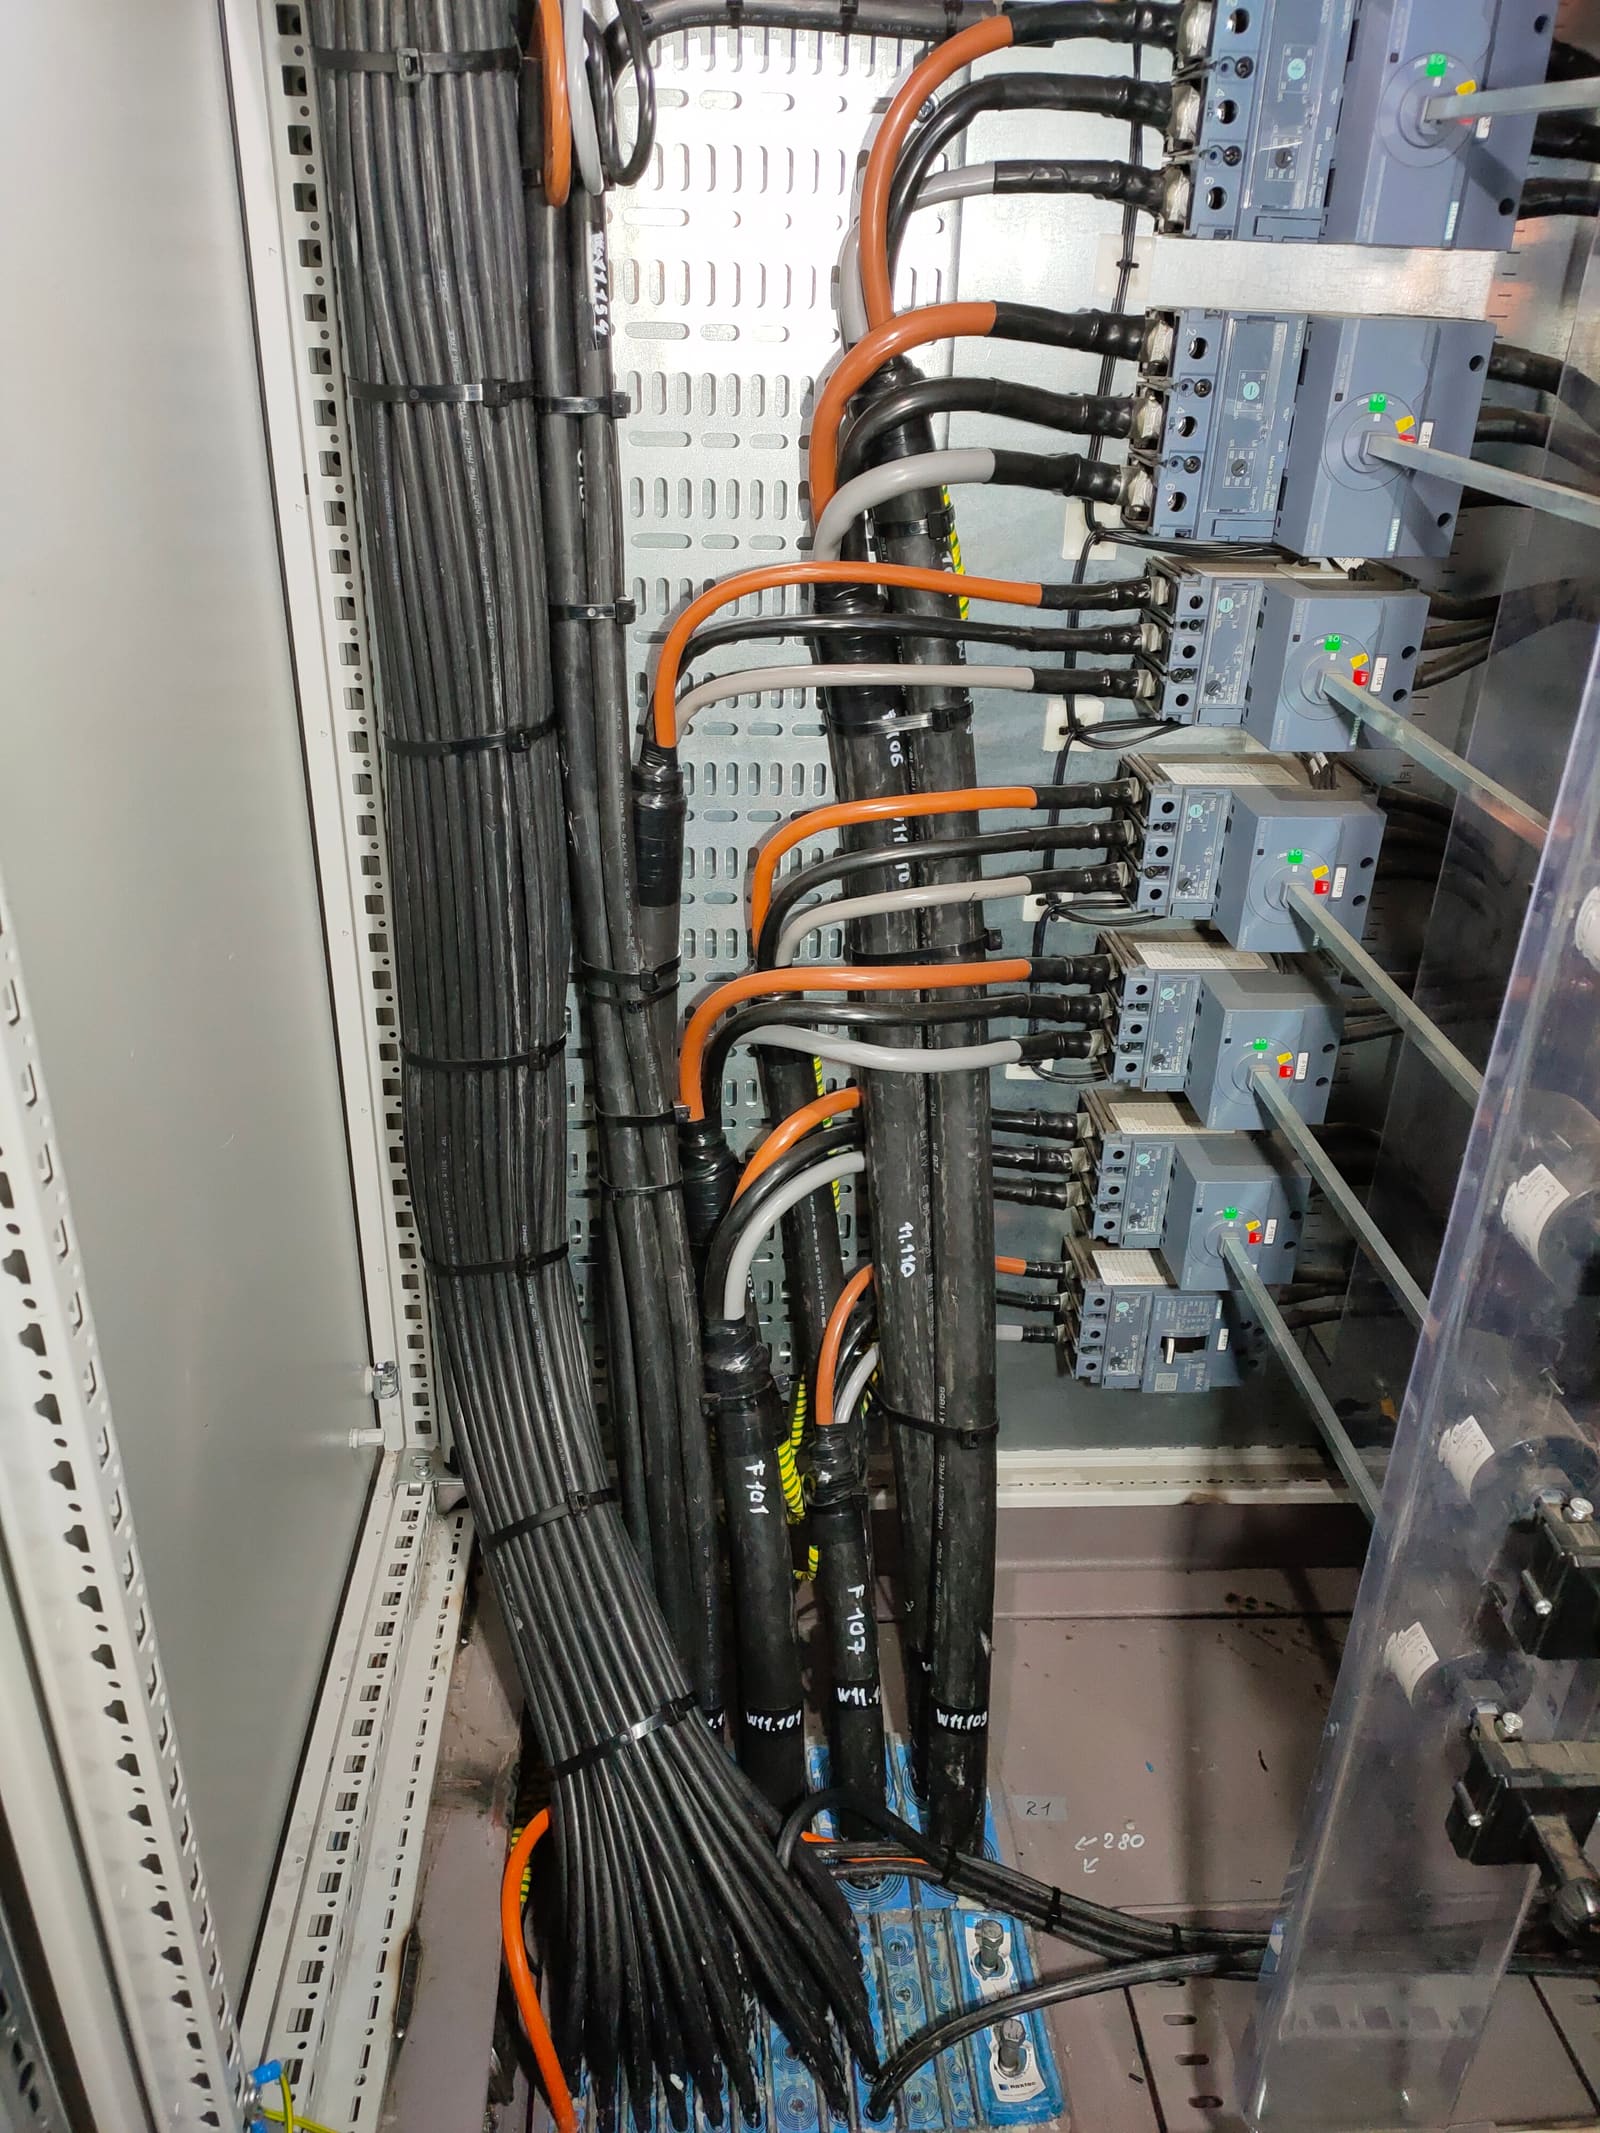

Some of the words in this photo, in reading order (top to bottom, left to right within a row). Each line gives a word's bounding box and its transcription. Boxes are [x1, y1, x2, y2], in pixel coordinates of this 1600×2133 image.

[1215, 87, 1226, 98] 4
[1204, 176, 1214, 185] 6
[1444, 202, 1459, 241] SIEMENS
[1186, 327, 1197, 337] 2
[1175, 406, 1185, 415] 4
[1166, 483, 1176, 491] 6
[1387, 518, 1401, 552] SIEMENS
[897, 1221, 917, 1278] 11.110
[746, 1710, 802, 1732] W11.101
